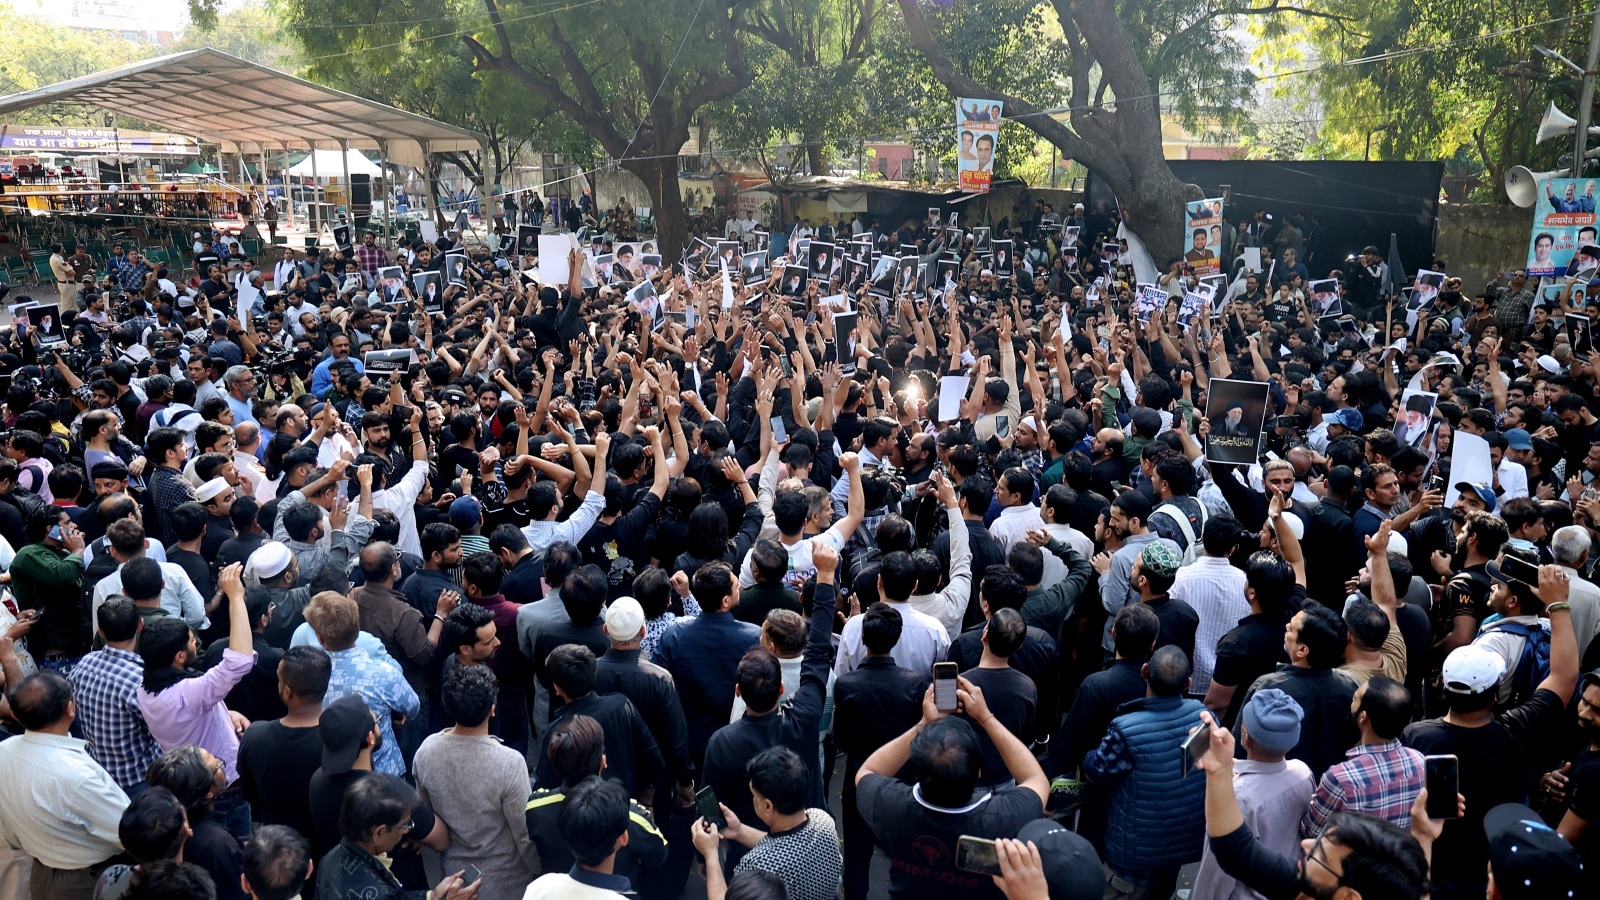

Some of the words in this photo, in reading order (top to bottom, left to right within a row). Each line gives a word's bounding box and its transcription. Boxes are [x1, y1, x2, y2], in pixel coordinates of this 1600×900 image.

[13, 138, 37, 147] याद
[40, 138, 55, 148] आ
[58, 138, 75, 148] रहे
[1548, 214, 1573, 225] सत्यमेव
[1575, 214, 1593, 225] जयते
